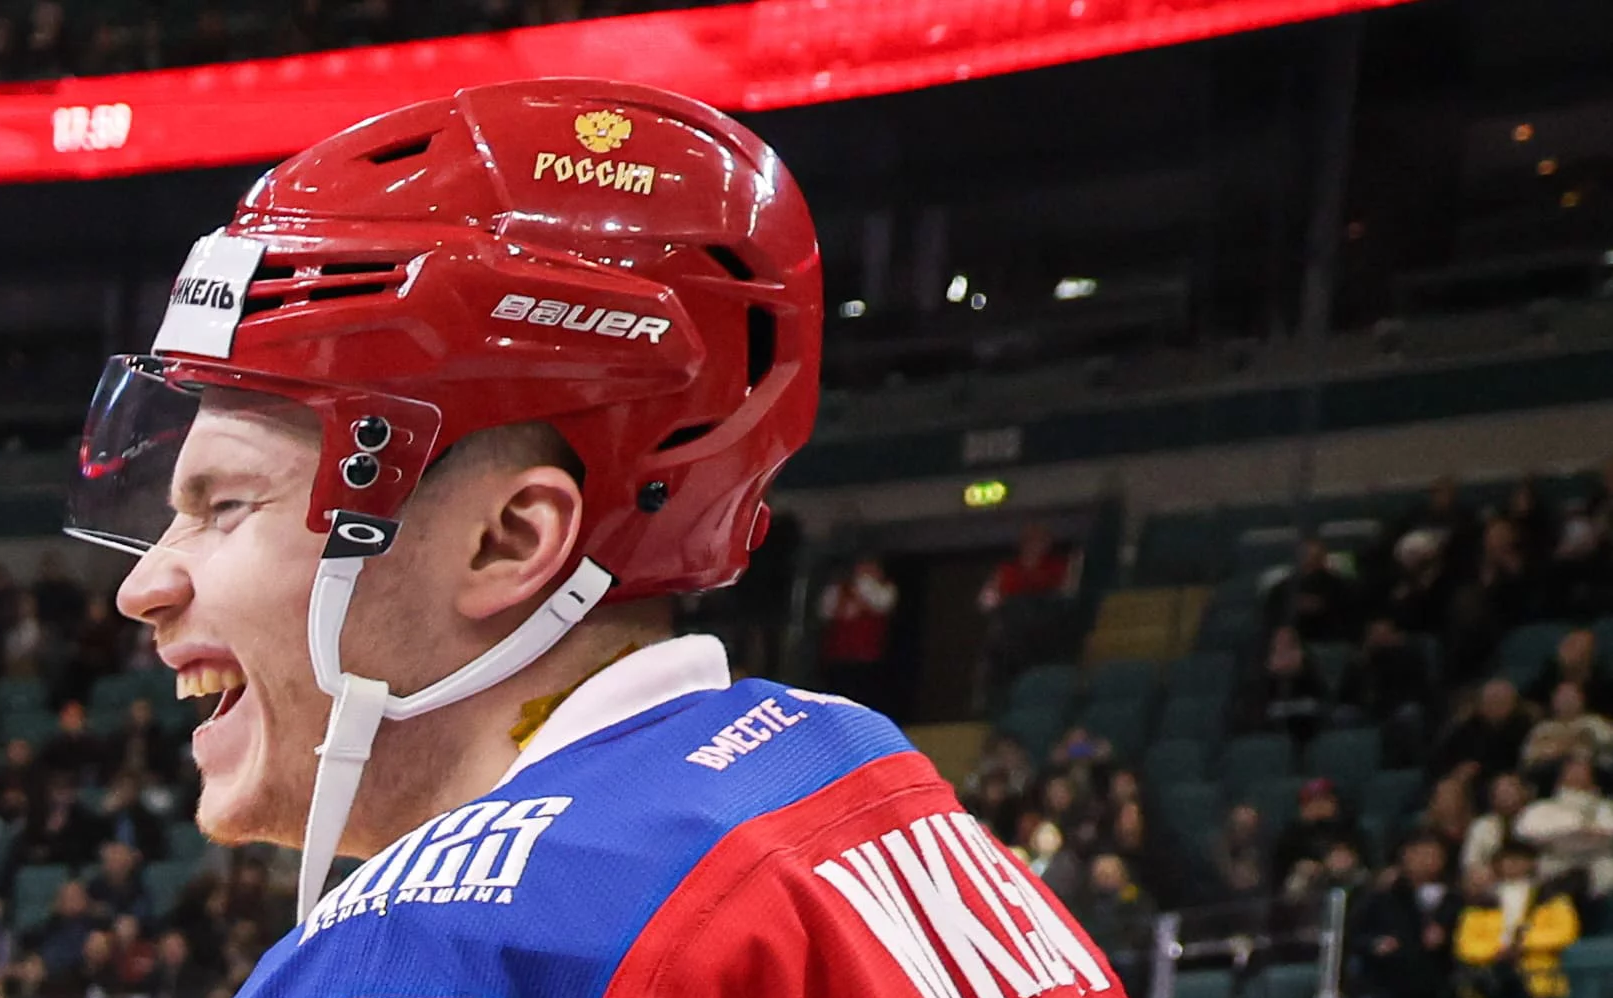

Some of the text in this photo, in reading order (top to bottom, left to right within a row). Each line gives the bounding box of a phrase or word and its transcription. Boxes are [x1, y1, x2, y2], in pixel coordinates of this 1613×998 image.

[533, 152, 656, 195] РОССИЯ
[490, 293, 673, 344] BAUER
[393, 885, 514, 905] МАШИНА
